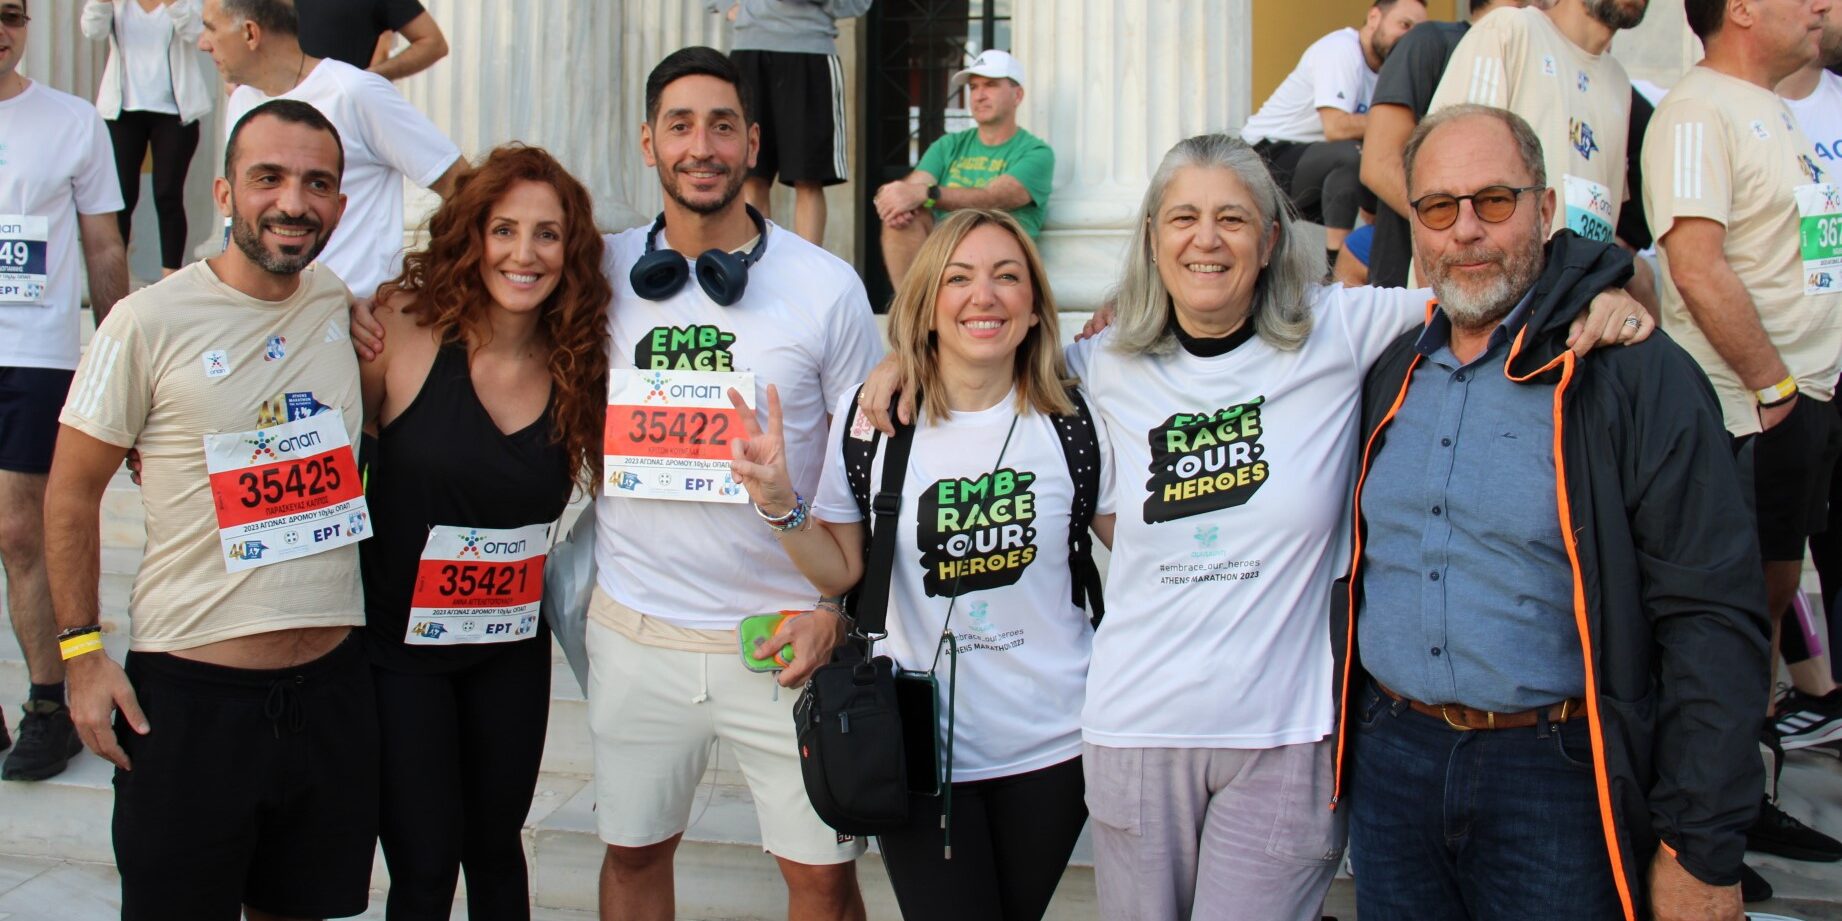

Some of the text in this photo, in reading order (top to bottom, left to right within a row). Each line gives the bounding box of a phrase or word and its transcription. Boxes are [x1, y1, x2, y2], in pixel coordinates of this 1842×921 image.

[628, 409, 730, 446] 35422
[1166, 409, 1260, 453] RACE
[624, 457, 639, 465] 2023
[238, 455, 342, 509] 35425
[1163, 462, 1267, 503] HEROES
[243, 523, 260, 533] 2023
[260, 517, 287, 529] ΑΓΩΝΑΣ
[288, 511, 318, 523] ΔΡΟΜΟΥ
[937, 492, 1034, 533] RACE
[313, 524, 342, 543] ΕΡΤ
[438, 562, 529, 597] 35421
[938, 547, 1035, 580] HEROES
[1160, 570, 1260, 585] ATHENS MARATHON 2023
[485, 623, 513, 635] ΕΡΤ
